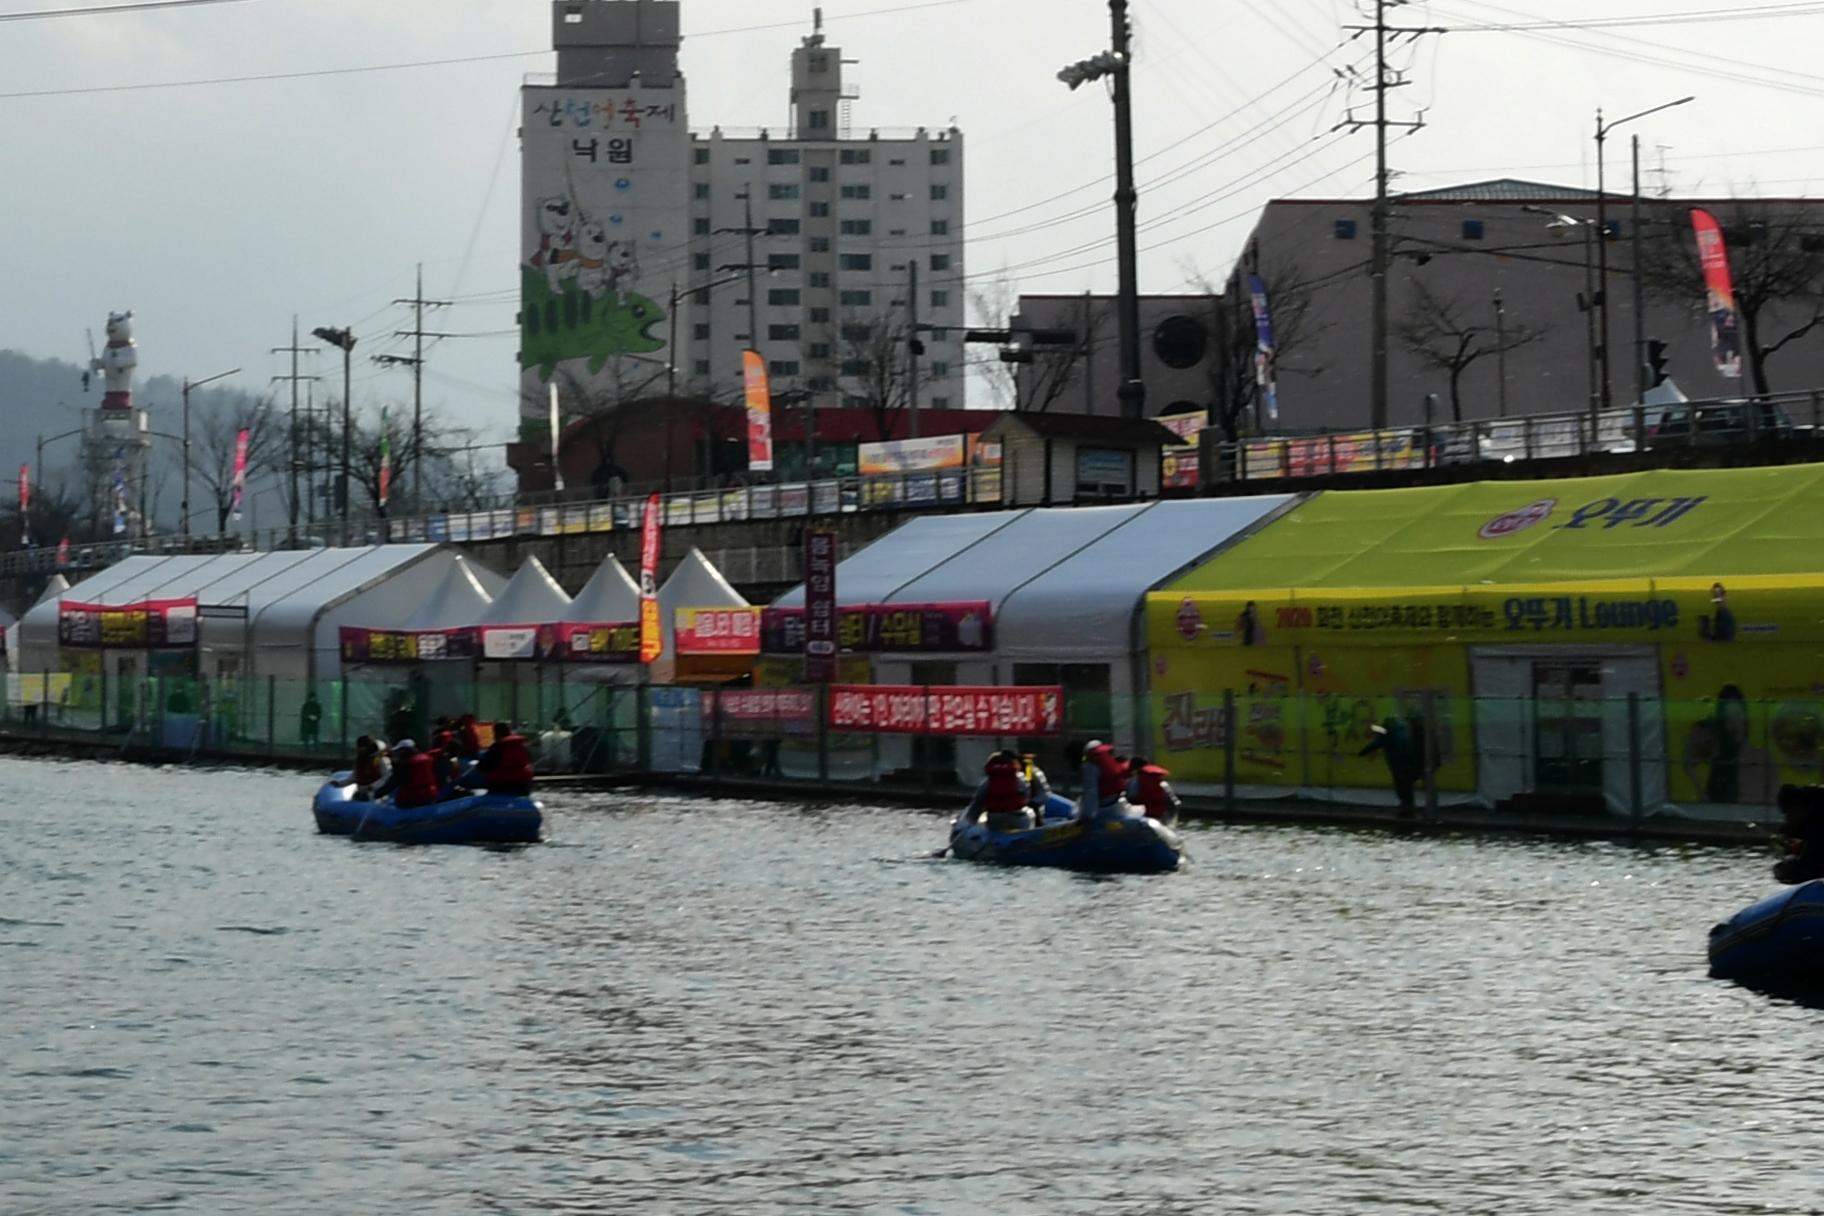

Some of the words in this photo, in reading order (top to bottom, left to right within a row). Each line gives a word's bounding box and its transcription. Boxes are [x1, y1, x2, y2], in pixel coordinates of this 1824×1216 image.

[534, 97, 675, 129] 산천어축제
[572, 138, 633, 164] 낙원
[1552, 495, 1709, 529] 오뚜기
[810, 599, 831, 636] 쉼터
[879, 611, 923, 648] 수유실
[1276, 606, 1312, 629] 2020
[1316, 606, 1344, 630] 화천
[1504, 596, 1573, 631] 오뚜기
[1579, 595, 1680, 631] Lounge
